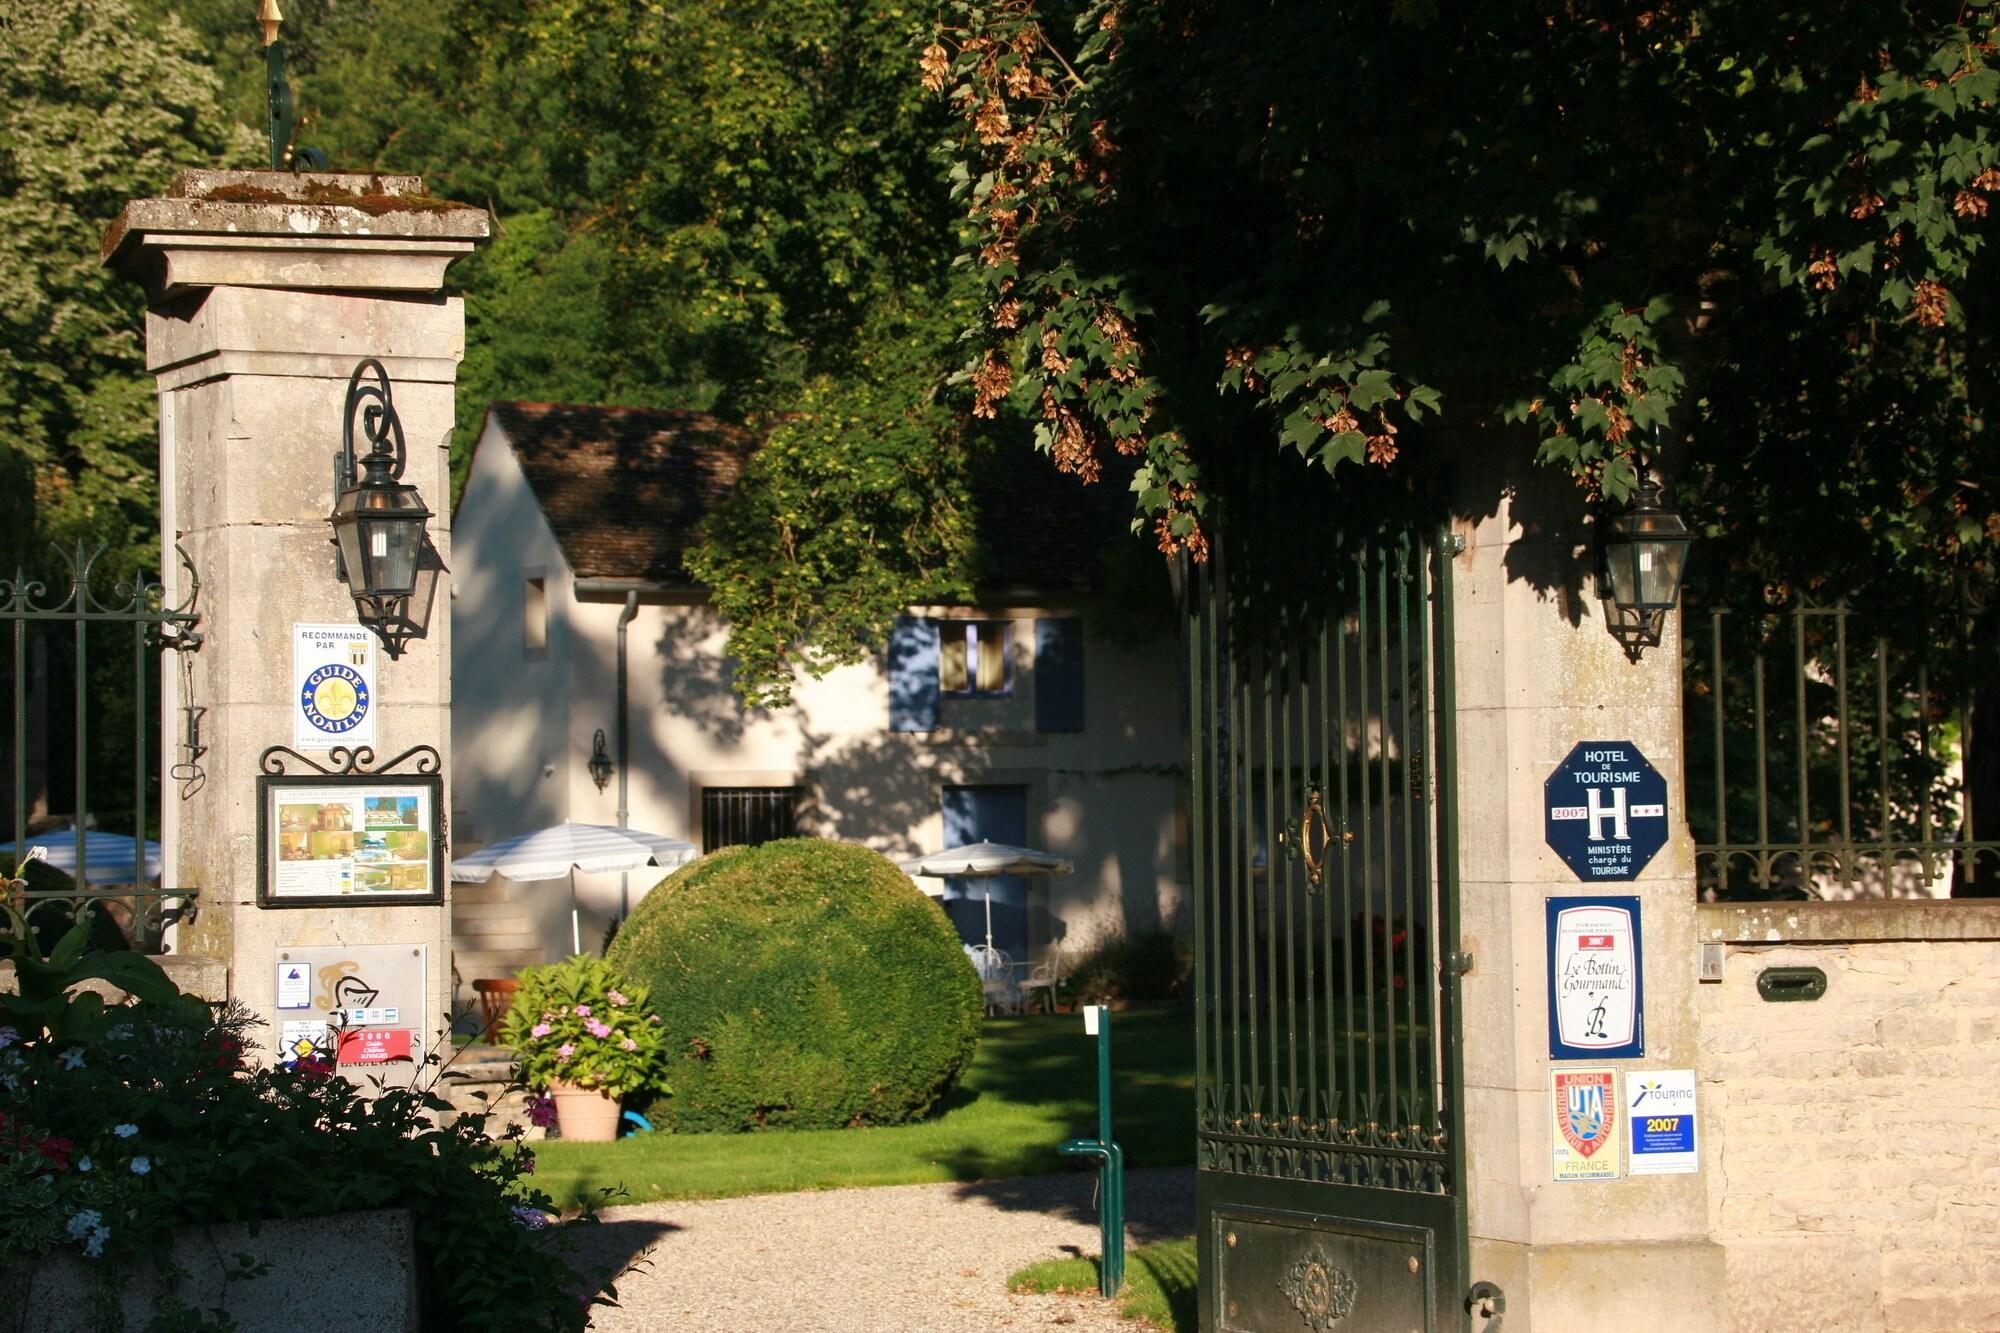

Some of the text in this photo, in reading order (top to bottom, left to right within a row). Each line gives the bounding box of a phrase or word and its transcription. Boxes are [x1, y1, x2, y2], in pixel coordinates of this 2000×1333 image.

[302, 631, 368, 640] RECOMMANDE
[316, 641, 335, 649] PAR
[310, 666, 362, 688] GUIDE
[303, 703, 367, 732] NOAILLE
[1585, 750, 1629, 762] HOTEL
[1573, 771, 1641, 783] TOURISME
[1553, 808, 1586, 818] 2007
[1586, 787, 1631, 841] H
[1588, 844, 1632, 854] MINISTÈRE
[1588, 855, 1632, 866] chargé du
[1591, 866, 1629, 875] TOURISME
[1564, 953, 1622, 976] Le Bottin
[1562, 969, 1629, 998] Gourmand
[1564, 1074, 1604, 1085] UNION
[1649, 1089, 1693, 1100] TOURING
[1568, 1086, 1604, 1126] UTA
[1557, 1086, 1585, 1150] TOURISTIQUE
[1592, 1083, 1614, 1151] AUTOMOBILE
[1647, 1118, 1679, 1132] 2007
[1566, 1160, 1609, 1171] FRANCE
